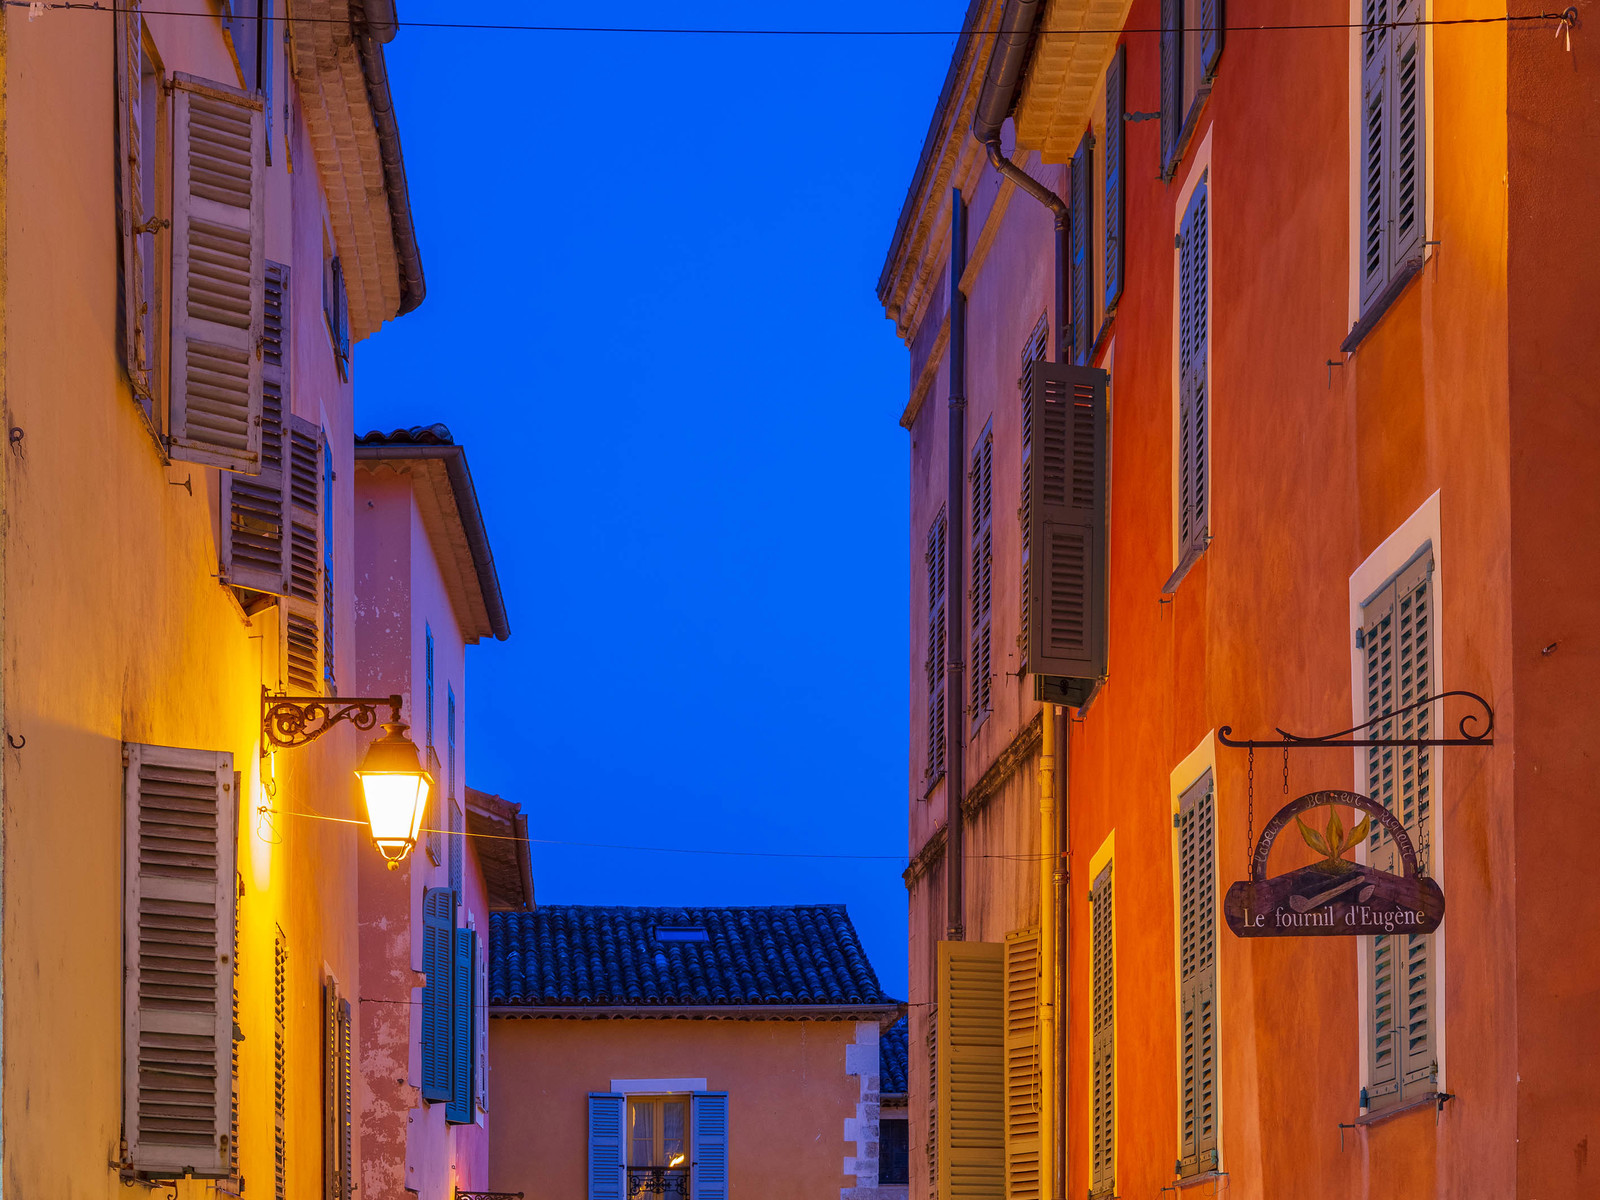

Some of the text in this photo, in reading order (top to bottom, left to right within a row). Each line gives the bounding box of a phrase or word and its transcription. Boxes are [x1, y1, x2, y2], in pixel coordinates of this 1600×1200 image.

[1243, 905, 1425, 932] Le fournil d'Eugène
